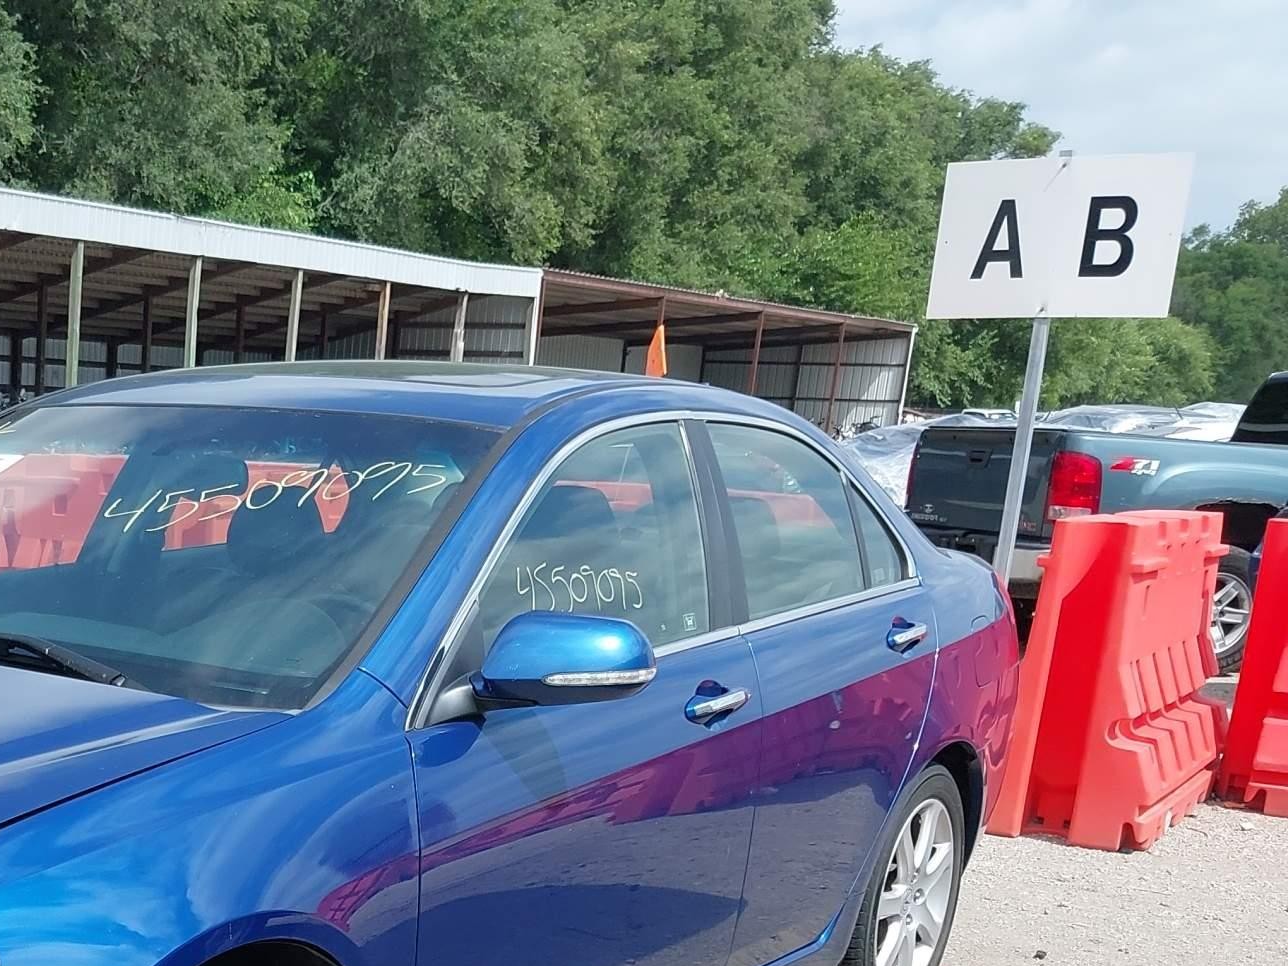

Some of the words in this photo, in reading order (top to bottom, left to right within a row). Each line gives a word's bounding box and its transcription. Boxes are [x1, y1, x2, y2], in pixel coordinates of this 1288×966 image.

[969, 198, 1024, 280] A
[1077, 195, 1139, 278] B
[103, 461, 447, 534] 45509095
[516, 562, 643, 613] 45509095
